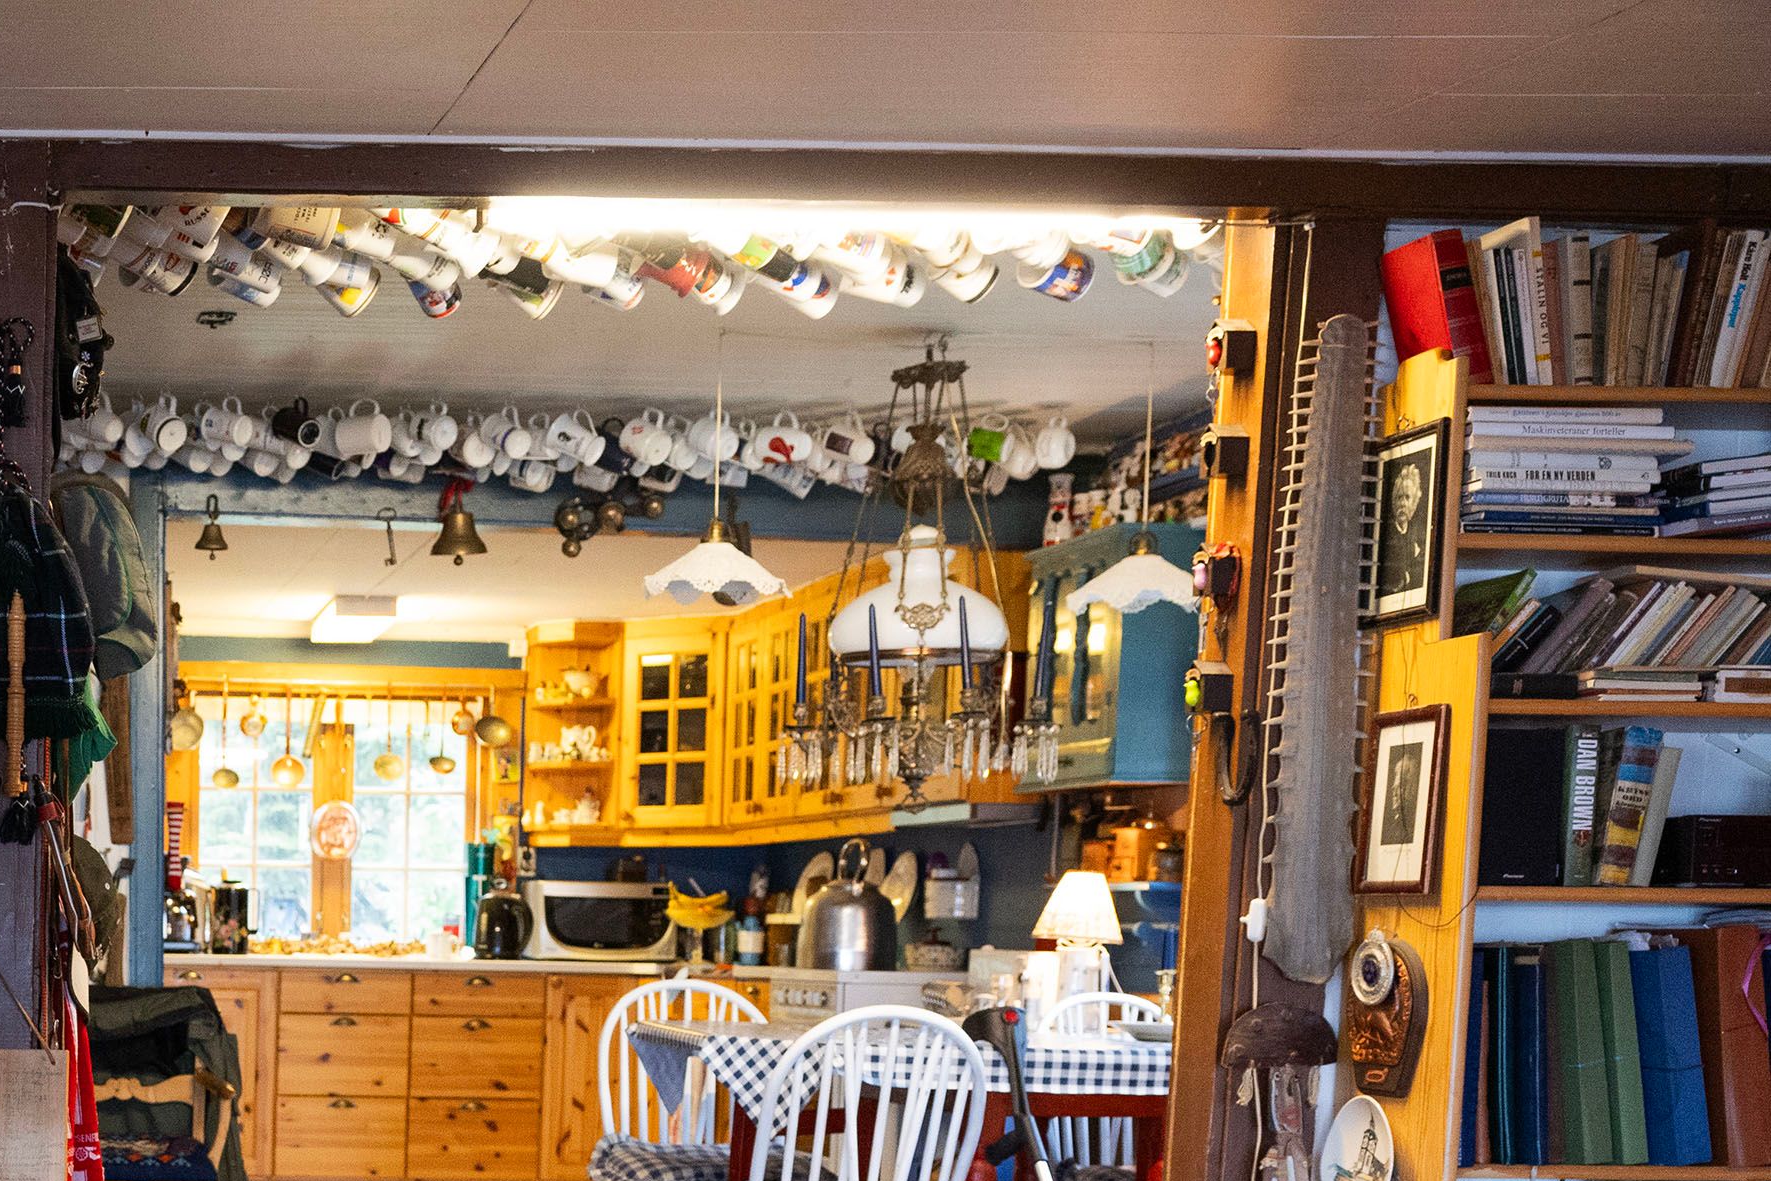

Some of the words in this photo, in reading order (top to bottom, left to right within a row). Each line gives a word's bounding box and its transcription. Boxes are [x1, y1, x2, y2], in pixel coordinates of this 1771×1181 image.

[1536, 268, 1546, 307] STALIN
[1540, 313, 1548, 329] OG
[1542, 333, 1549, 344] VI
[1522, 425, 1590, 435] Maskinveteraner
[1593, 427, 1626, 436] forteller
[1525, 470, 1540, 480] FOR
[1542, 471, 1552, 480] EN
[1554, 471, 1564, 480] NY
[1566, 471, 1596, 481] VERDEN
[1576, 739, 1598, 770] DAN
[1572, 775, 1596, 831] BROWN
